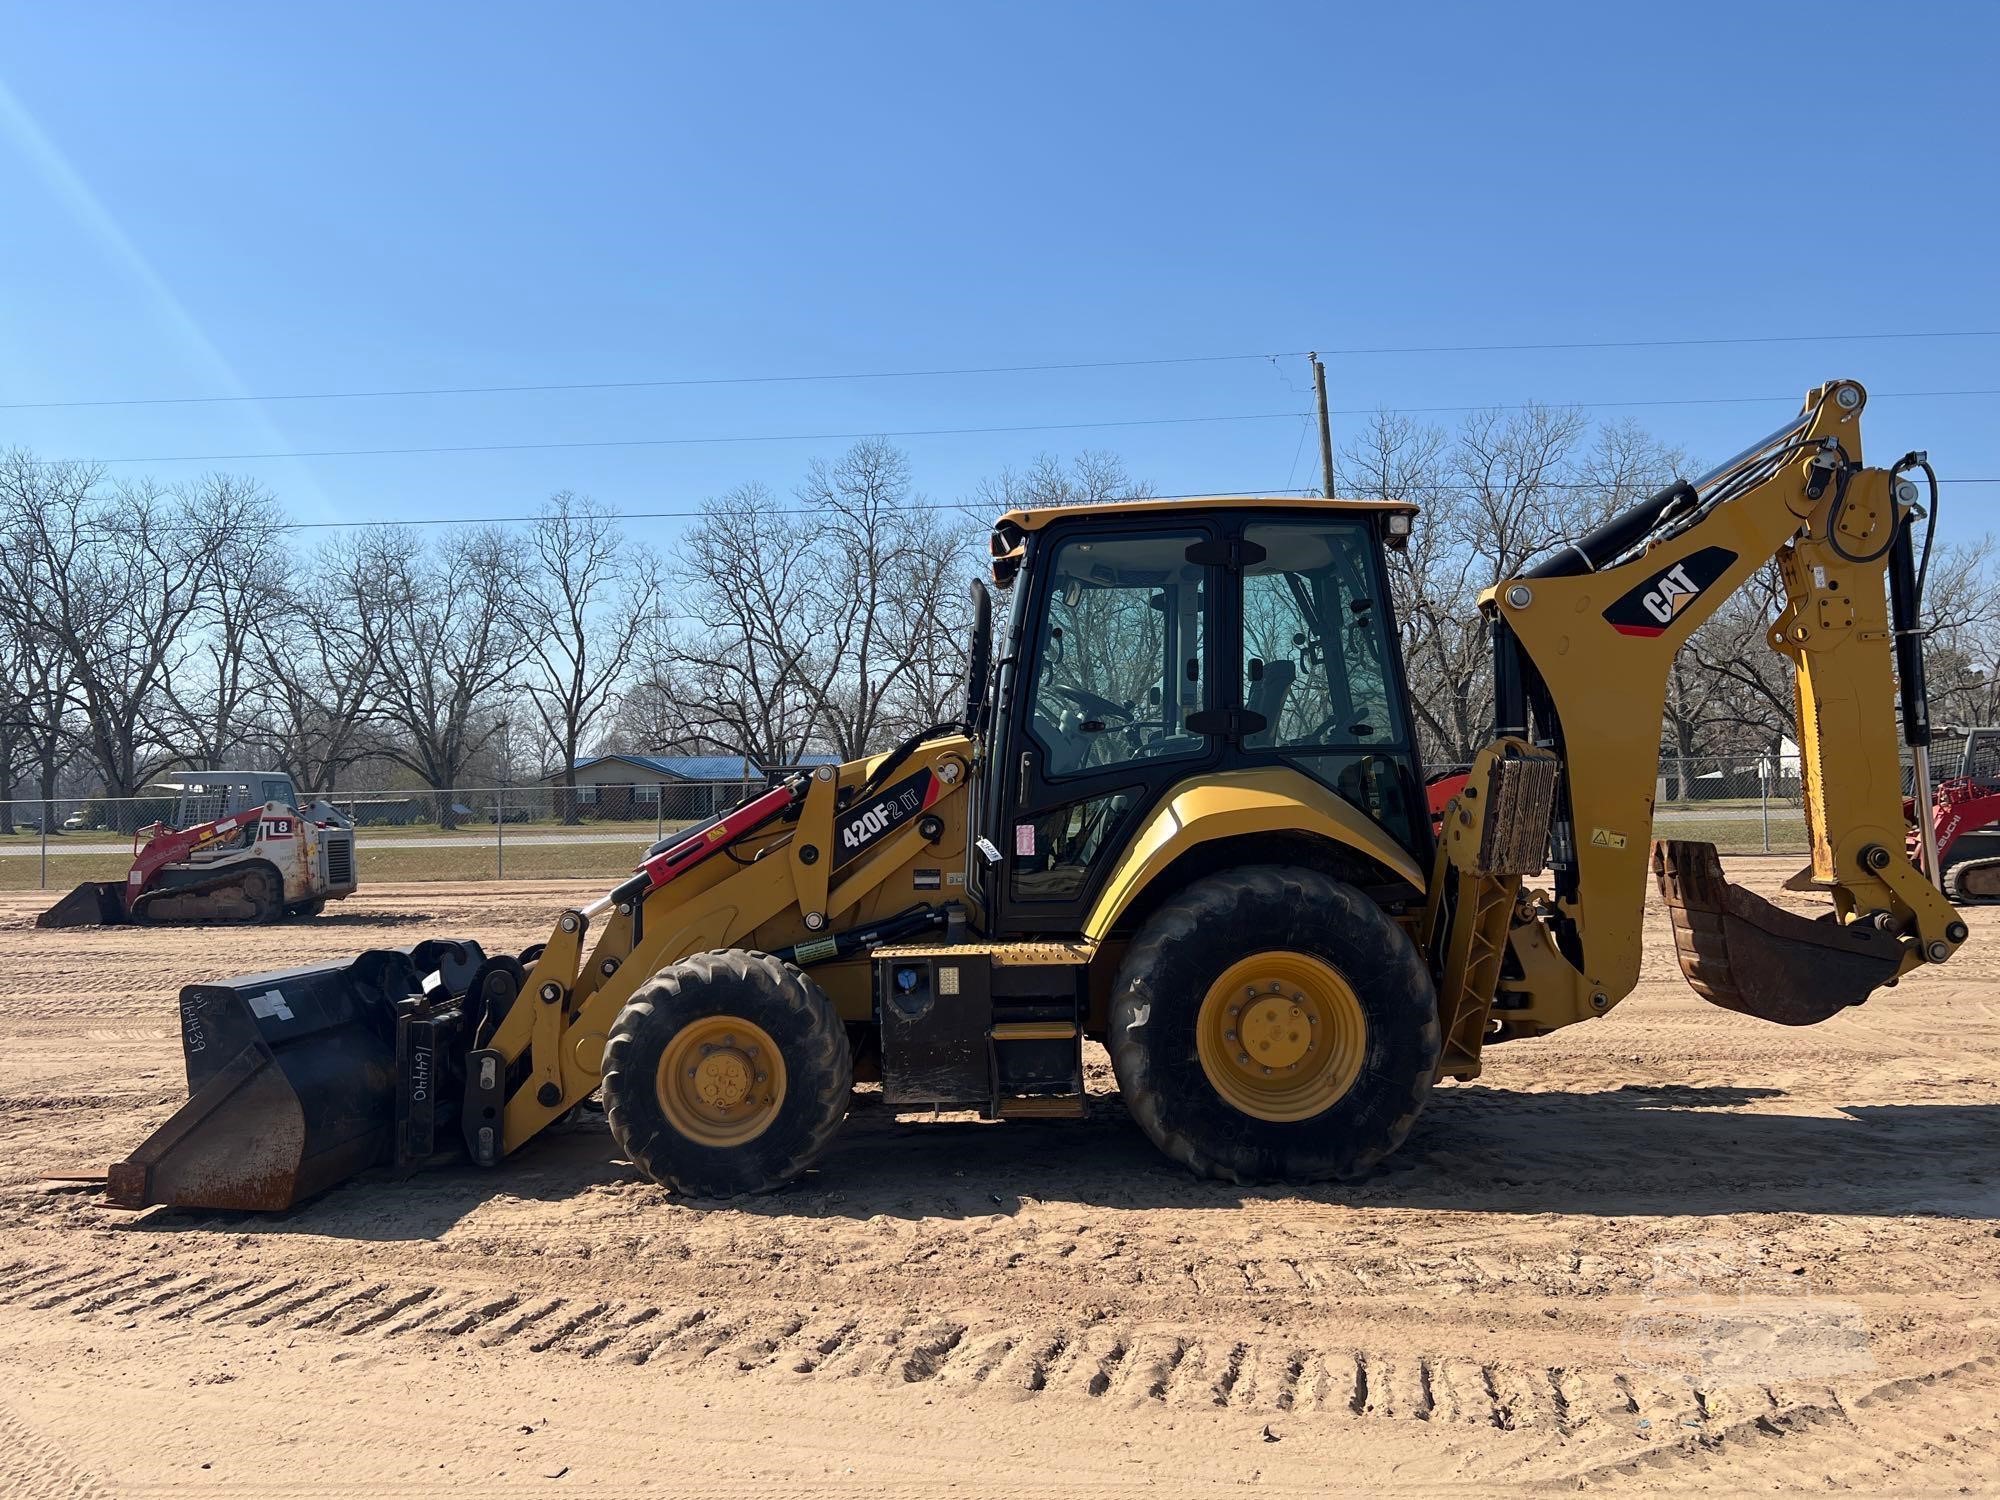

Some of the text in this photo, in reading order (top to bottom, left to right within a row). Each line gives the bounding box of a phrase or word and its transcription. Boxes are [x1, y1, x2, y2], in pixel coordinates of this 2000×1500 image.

[1642, 563, 1700, 623] CAT
[900, 788, 919, 811] IT
[260, 820, 295, 842] TL8
[412, 1045, 433, 1101] 164440
